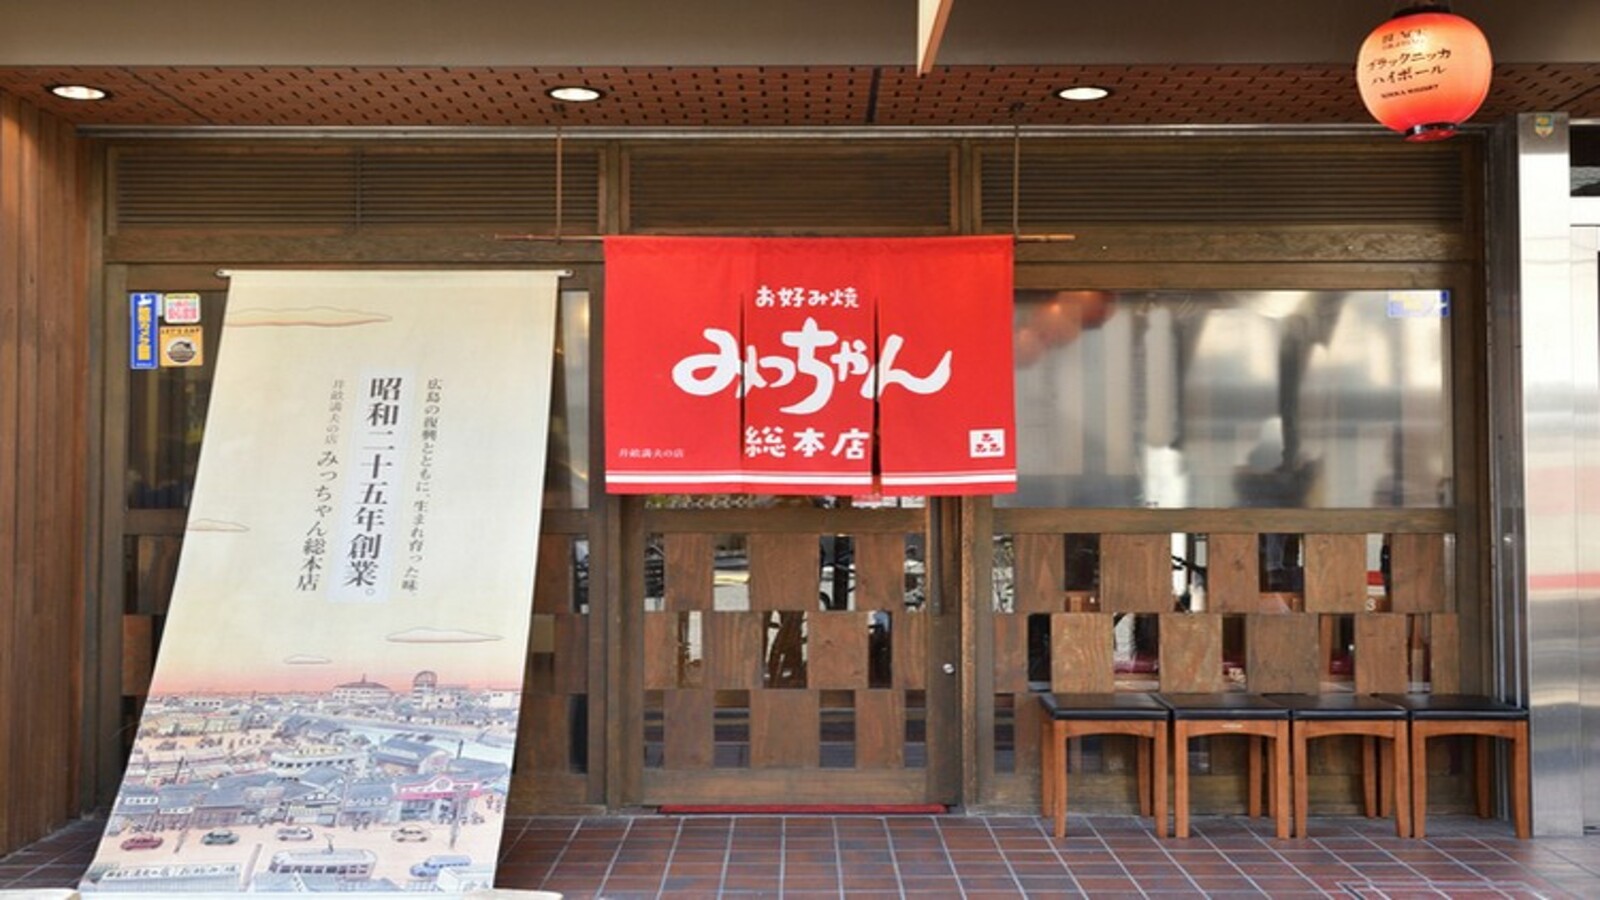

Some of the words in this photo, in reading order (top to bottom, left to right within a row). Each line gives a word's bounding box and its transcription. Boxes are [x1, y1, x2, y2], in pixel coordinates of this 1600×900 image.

[754, 284, 860, 309] お好み焼
[672, 317, 953, 415] みっちゃん
[744, 426, 870, 459] 総本店
[345, 377, 402, 597] 昭和二十五年創業。
